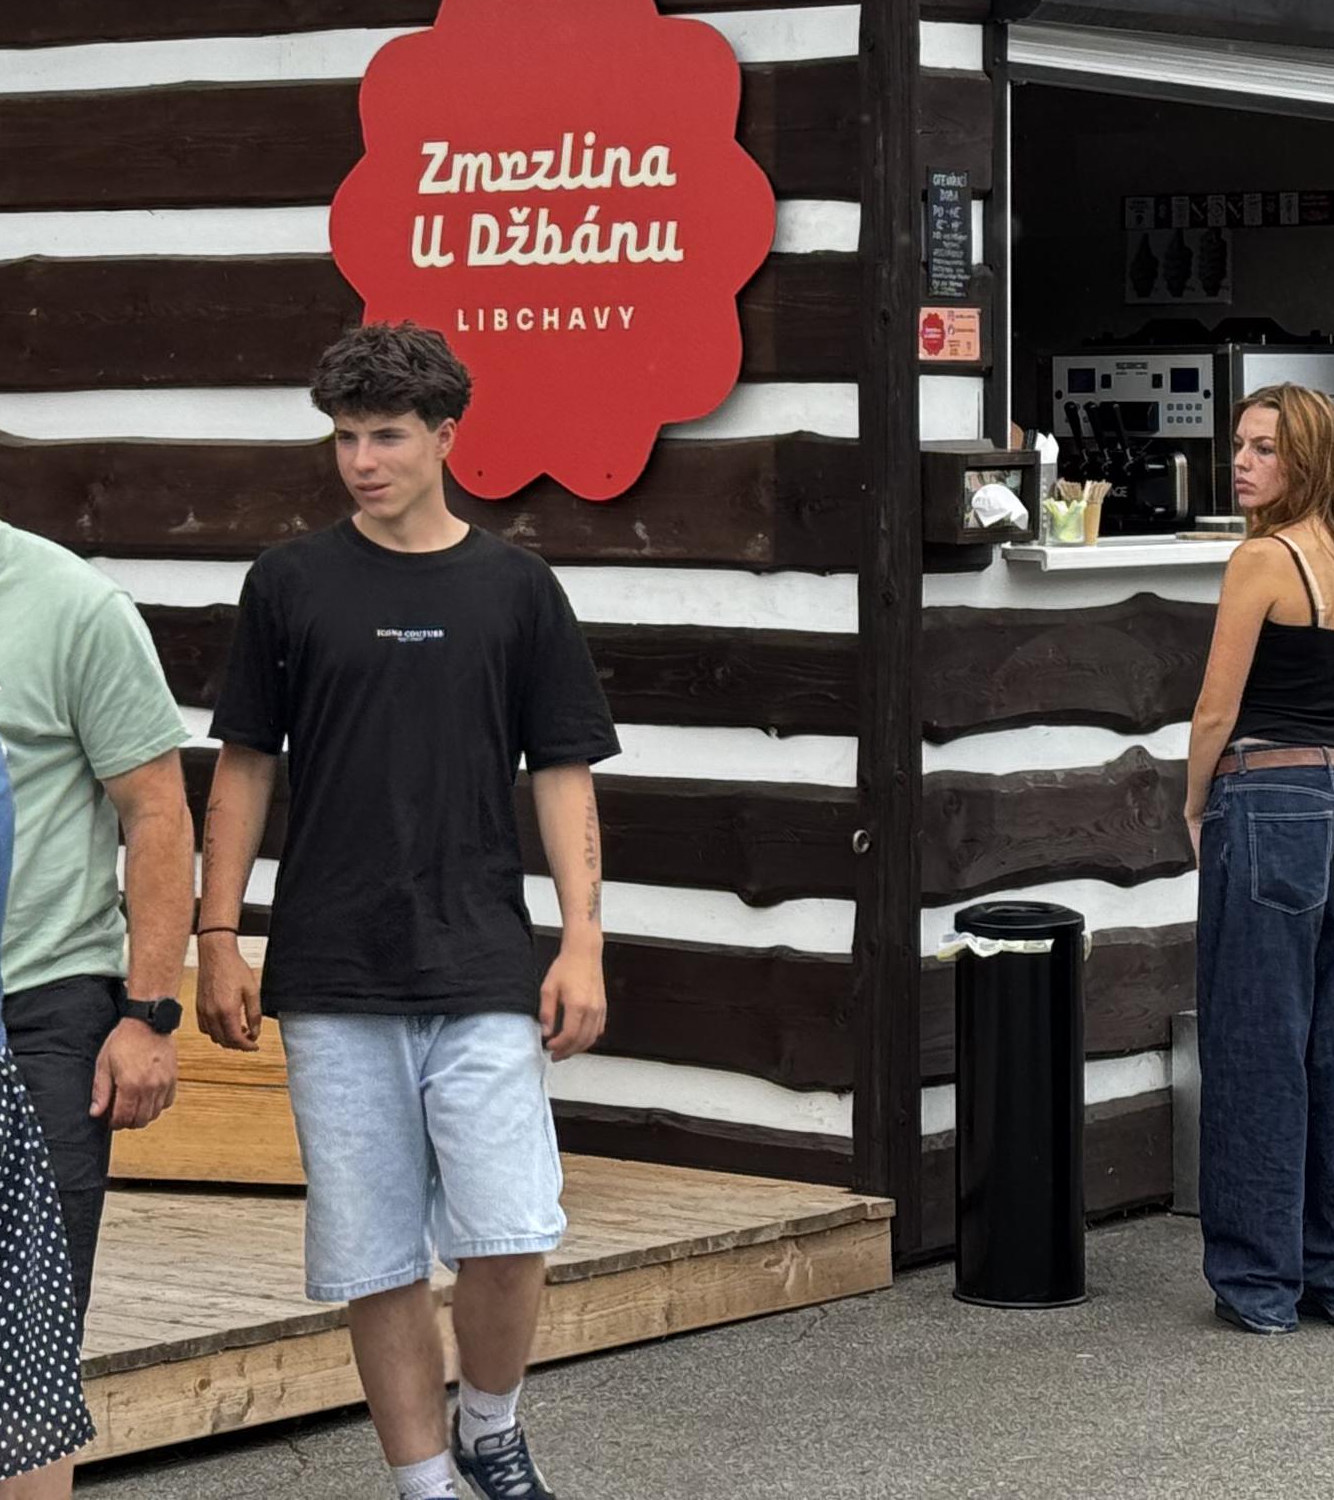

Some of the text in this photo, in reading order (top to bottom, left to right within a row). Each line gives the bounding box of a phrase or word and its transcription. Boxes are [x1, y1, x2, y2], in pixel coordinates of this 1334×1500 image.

[418, 131, 677, 194] Zmrzlina
[411, 205, 684, 268] U Džbánu
[457, 306, 636, 332] LIBCHAVY
